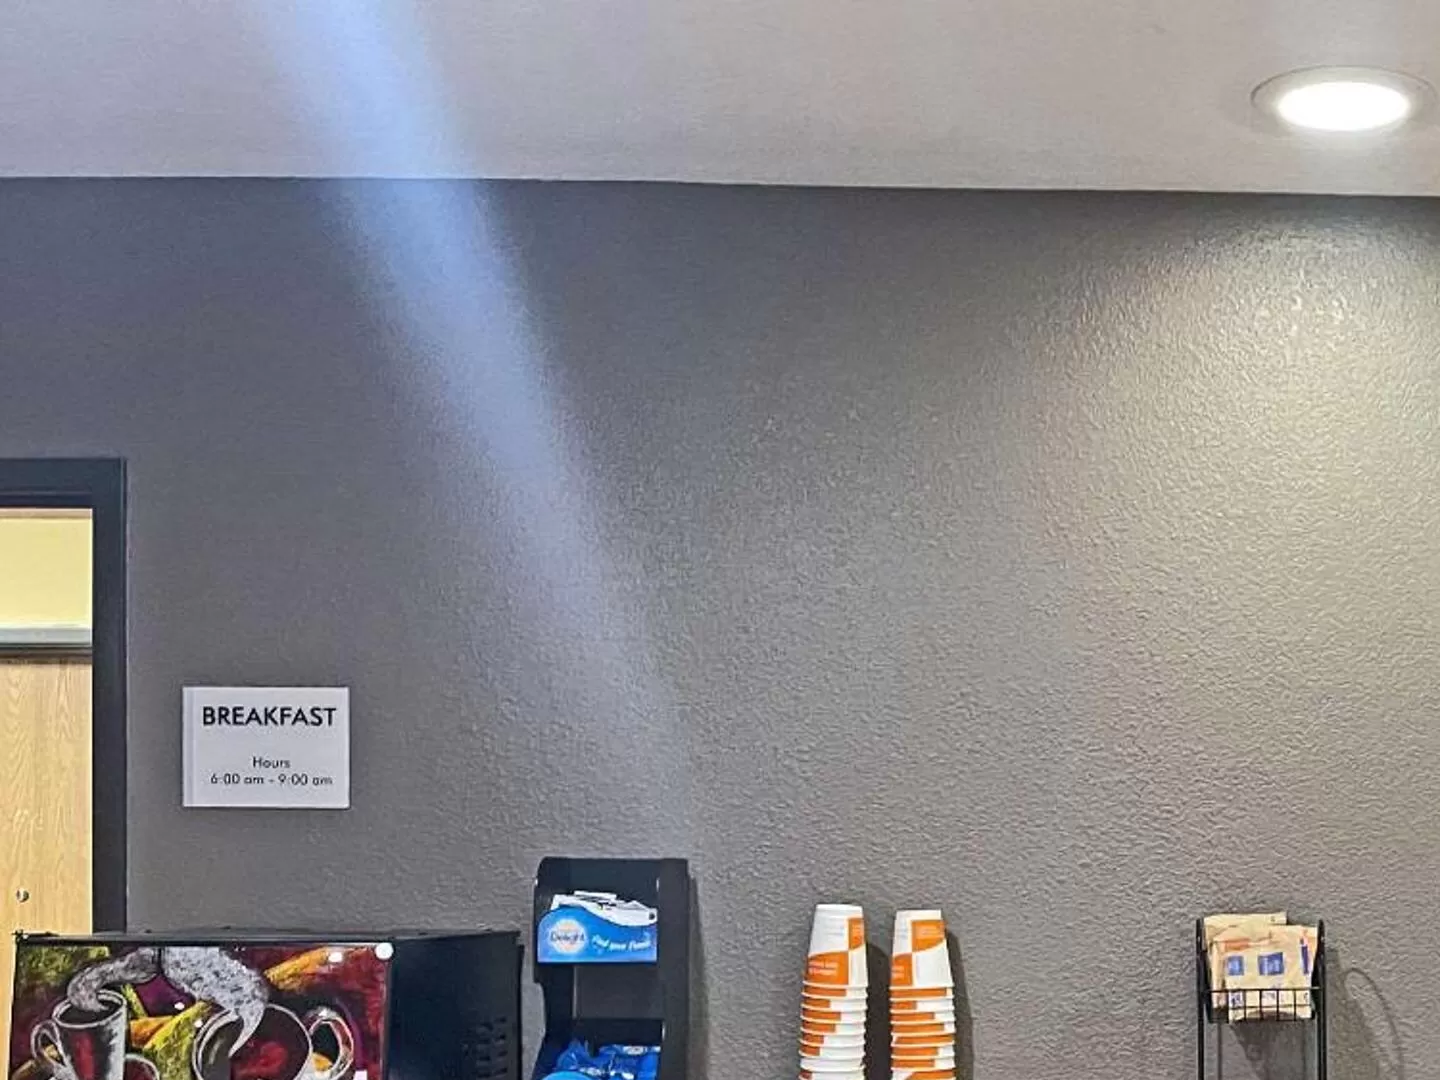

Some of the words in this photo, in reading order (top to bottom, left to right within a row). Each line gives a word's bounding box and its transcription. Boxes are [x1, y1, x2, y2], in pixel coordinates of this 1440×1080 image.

[202, 706, 337, 726] BREAKFAST
[252, 756, 291, 769] Hours
[210, 773, 241, 785] 6:00
[243, 776, 265, 785] am
[277, 773, 309, 786] 9:00
[312, 776, 334, 786] am
